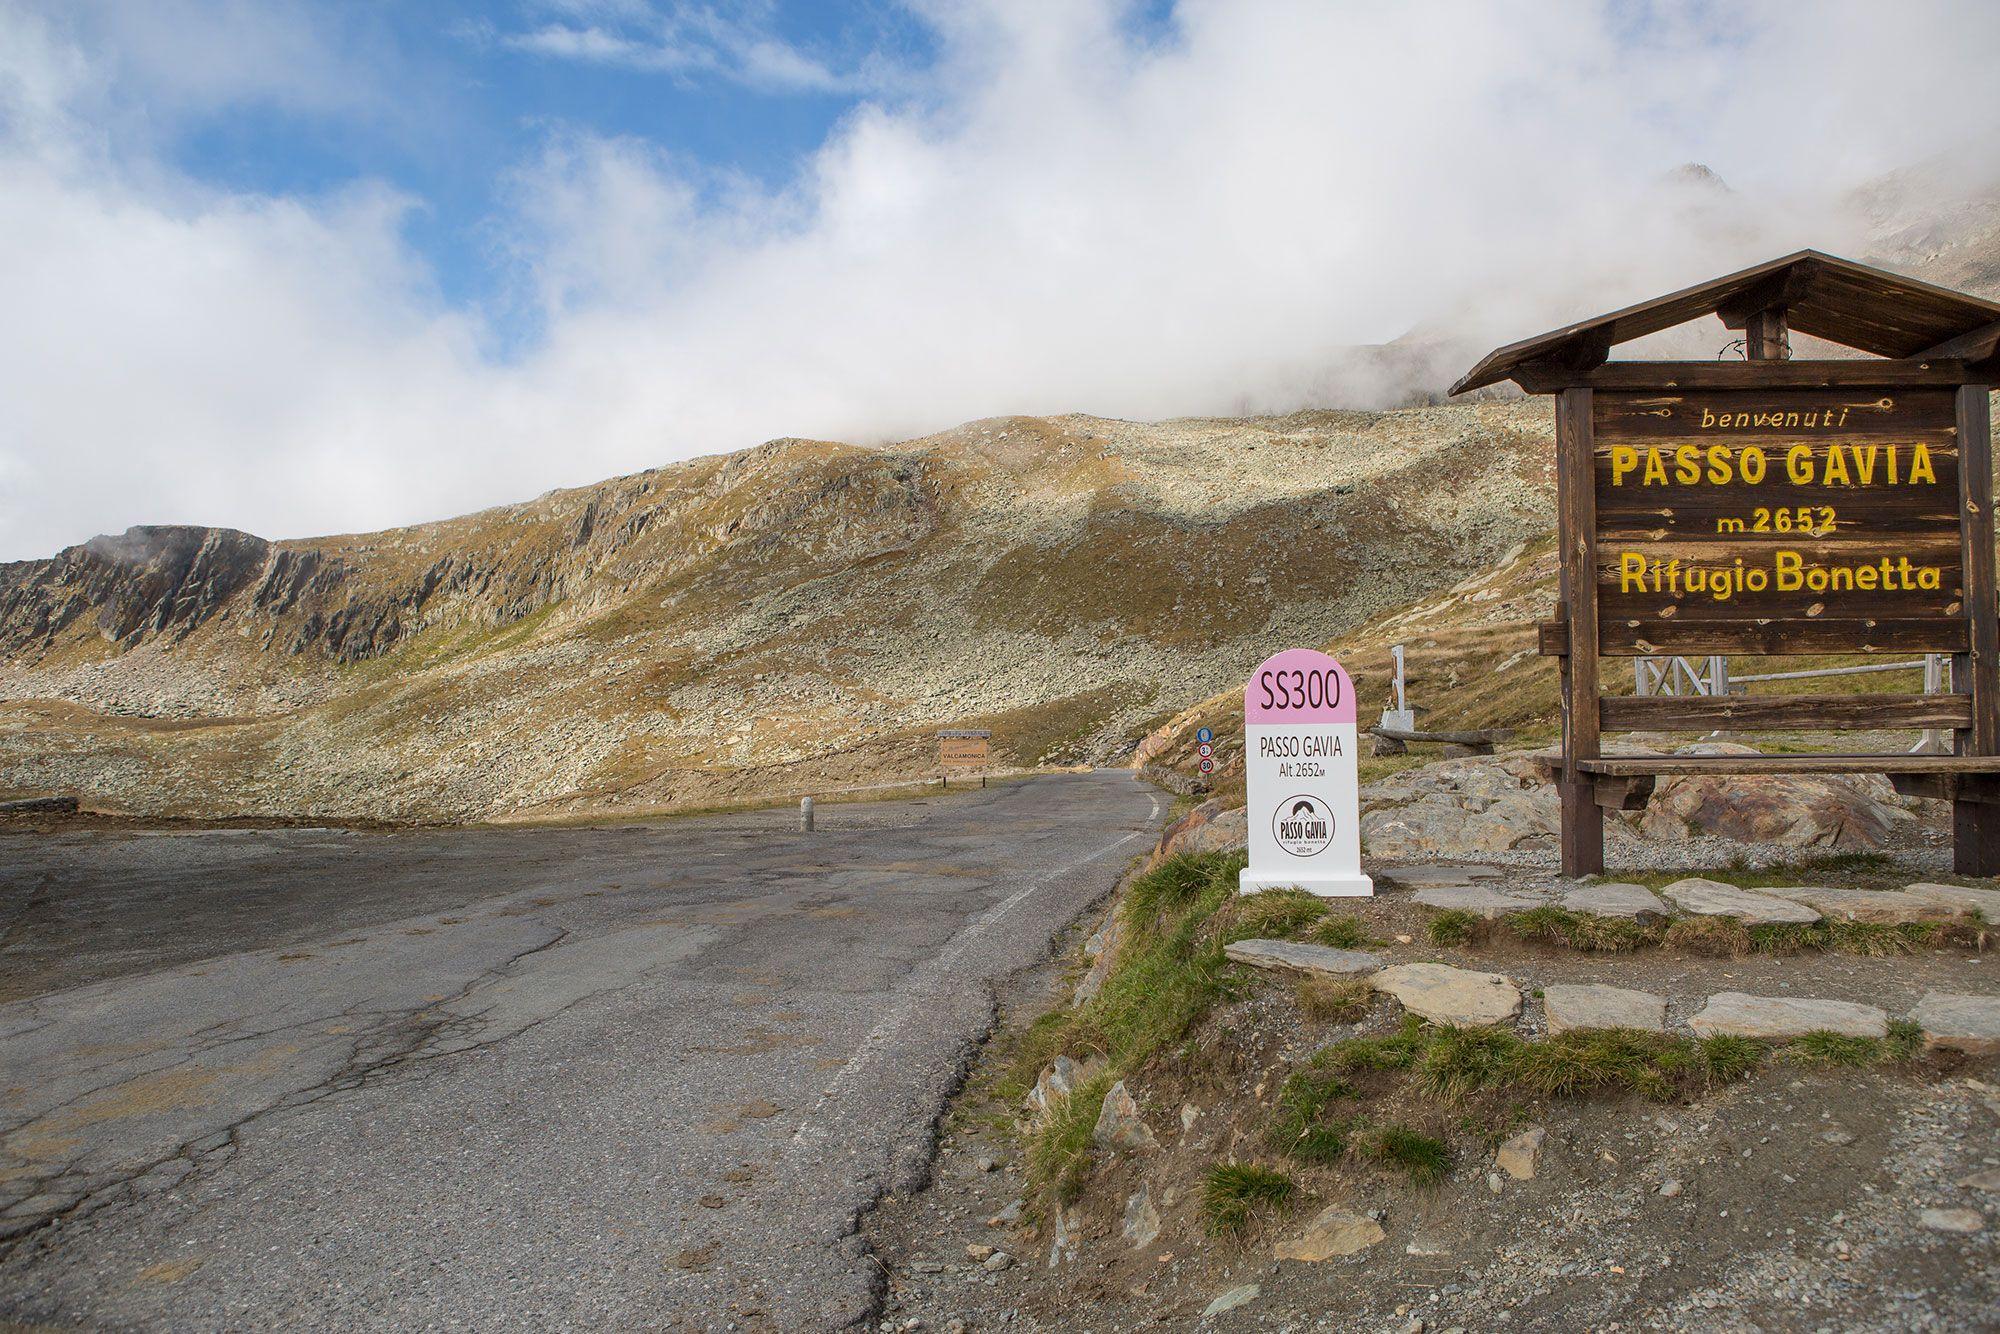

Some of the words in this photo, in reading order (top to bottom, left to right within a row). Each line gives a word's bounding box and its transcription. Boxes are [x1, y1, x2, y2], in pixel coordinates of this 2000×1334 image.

[1701, 408, 1849, 428] benvenuti
[1612, 445, 1767, 486] PASSO
[1786, 443, 1936, 485] GAVIA
[1620, 551, 1767, 600] Rifugio
[1776, 550, 1941, 592] Bonetta
[1261, 669, 1341, 710] SS300
[1260, 736, 1299, 758] PASSO
[1303, 735, 1343, 757] GAVIA
[1202, 761, 1211, 770] 30
[1280, 821, 1303, 840] PASSO
[1305, 821, 1327, 839] GAVIA
